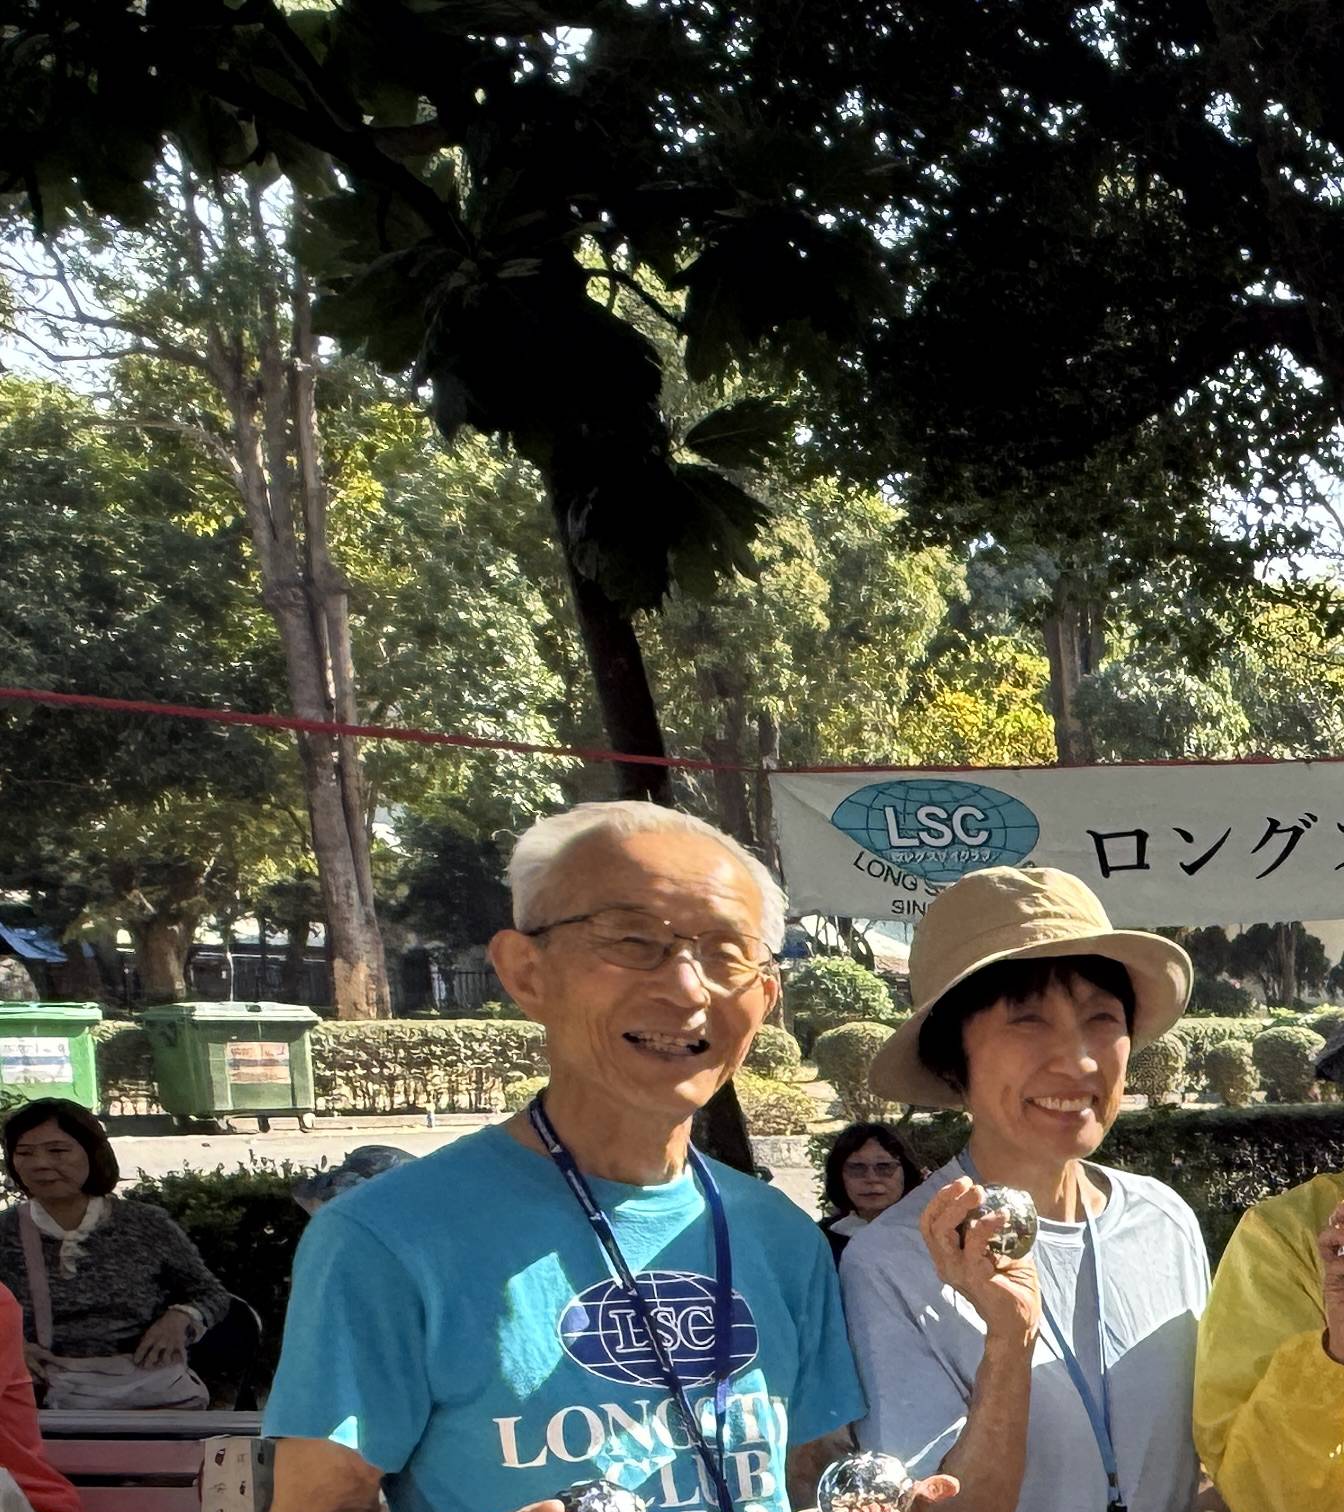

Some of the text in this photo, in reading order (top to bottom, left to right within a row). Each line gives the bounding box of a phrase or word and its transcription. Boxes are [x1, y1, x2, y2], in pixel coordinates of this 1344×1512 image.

[884, 804, 992, 848] LSC
[852, 850, 919, 891] LONG
[891, 900, 927, 917] SIN
[608, 1305, 716, 1353] LSC
